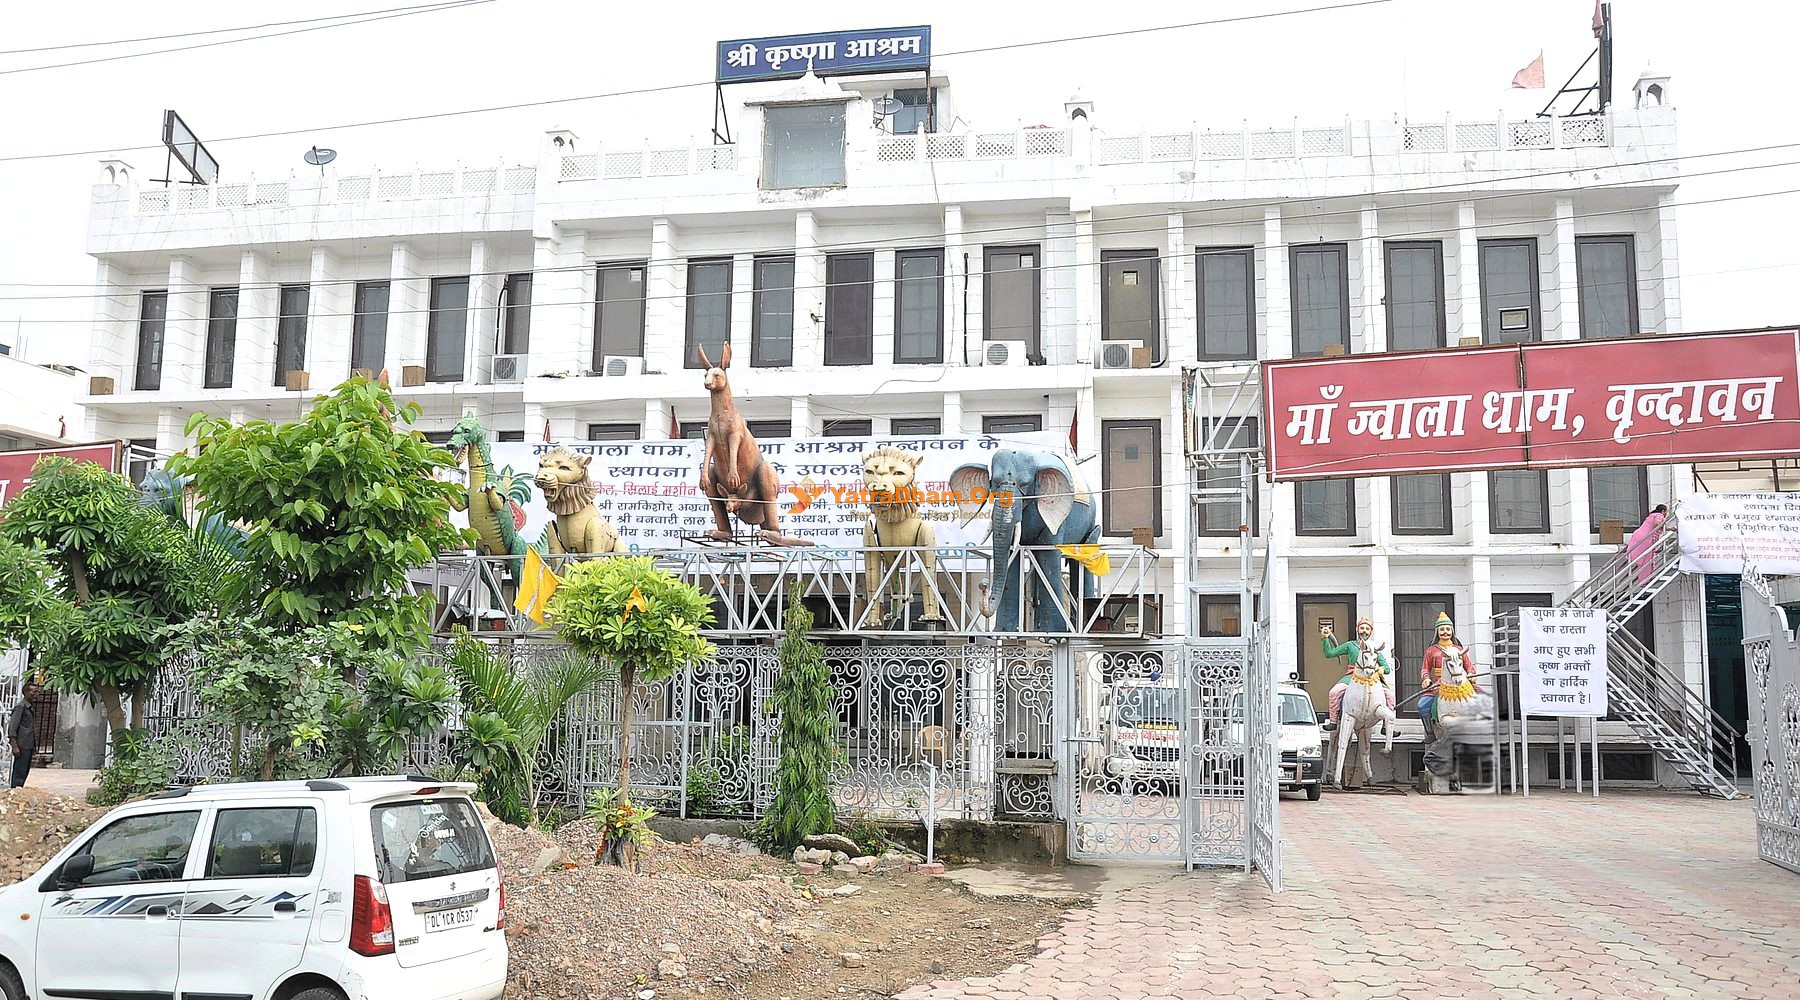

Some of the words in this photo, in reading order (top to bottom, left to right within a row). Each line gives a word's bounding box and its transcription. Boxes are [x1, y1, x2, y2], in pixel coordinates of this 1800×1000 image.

[727, 43, 759, 68] श्री
[765, 41, 837, 70] कृष्णा
[843, 35, 922, 59] आश्रम
[1285, 384, 1345, 446] माँ
[1347, 394, 1473, 441] ज्वाला
[1481, 387, 1586, 438] धाम,
[1605, 375, 1784, 444] वृन्दावन
[642, 444, 692, 458] धाम,
[794, 441, 868, 453] आश्रम
[977, 435, 1001, 450] के
[608, 466, 692, 478] स्थापना
[1542, 625, 1556, 634] का
[1559, 625, 1587, 634] रास्ता
[1533, 646, 1554, 655] आए
[1557, 646, 1570, 658] हुए
[1574, 643, 1596, 656] सभी
[1538, 661, 1560, 674] कृष्ण
[1563, 659, 1591, 672] भक्तों
[1542, 677, 1556, 687] का
[1559, 675, 1588, 688] हार्दिक
[1540, 693, 1576, 703] स्वागत
[431, 915, 441, 928] DL
[442, 912, 455, 926] 1CR
[456, 909, 473, 923] 0537
